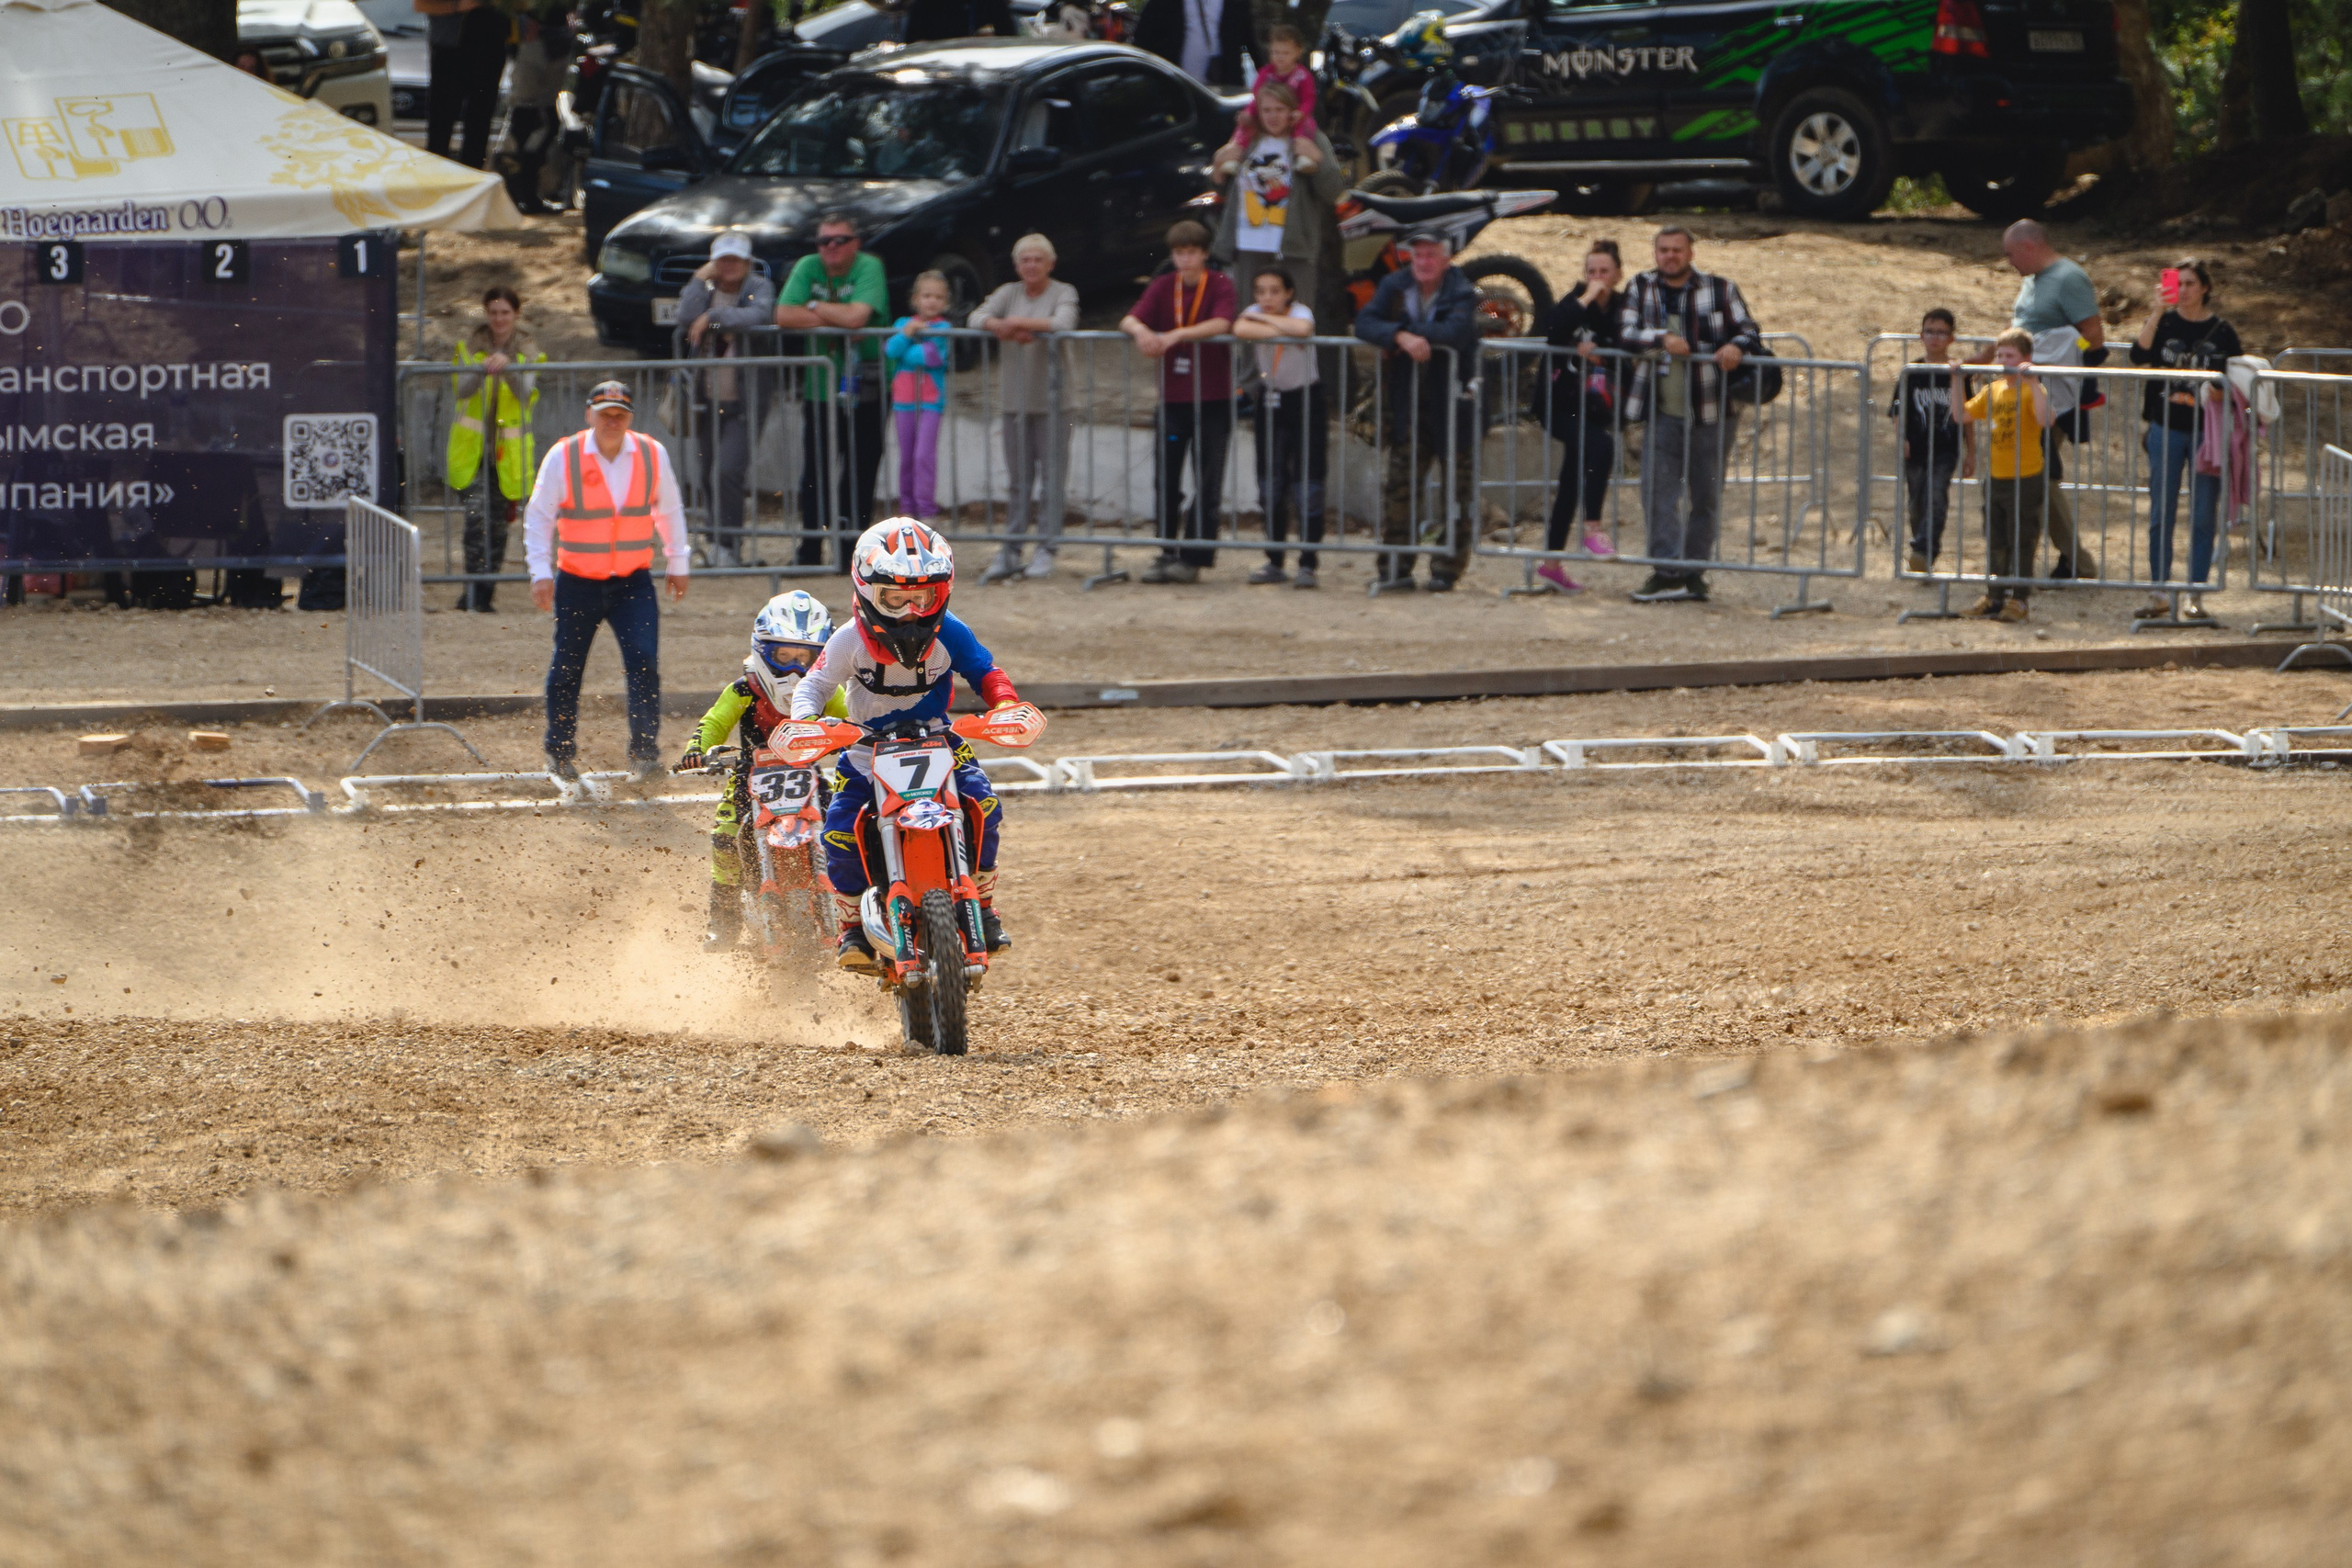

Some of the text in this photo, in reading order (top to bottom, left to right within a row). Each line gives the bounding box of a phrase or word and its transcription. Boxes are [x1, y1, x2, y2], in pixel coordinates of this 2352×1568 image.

[1544, 44, 1698, 79] MONSTER
[1, 200, 169, 241] Hoegaarden
[50, 245, 69, 280] 3
[215, 243, 234, 278] 2
[353, 240, 368, 274] 1
[0, 362, 271, 400] анспортная
[0, 480, 175, 510] пания»
[790, 739, 832, 748] ACERBIS
[759, 770, 812, 804] 33
[899, 755, 930, 791] 7
[966, 902, 978, 940] DUNLOP
